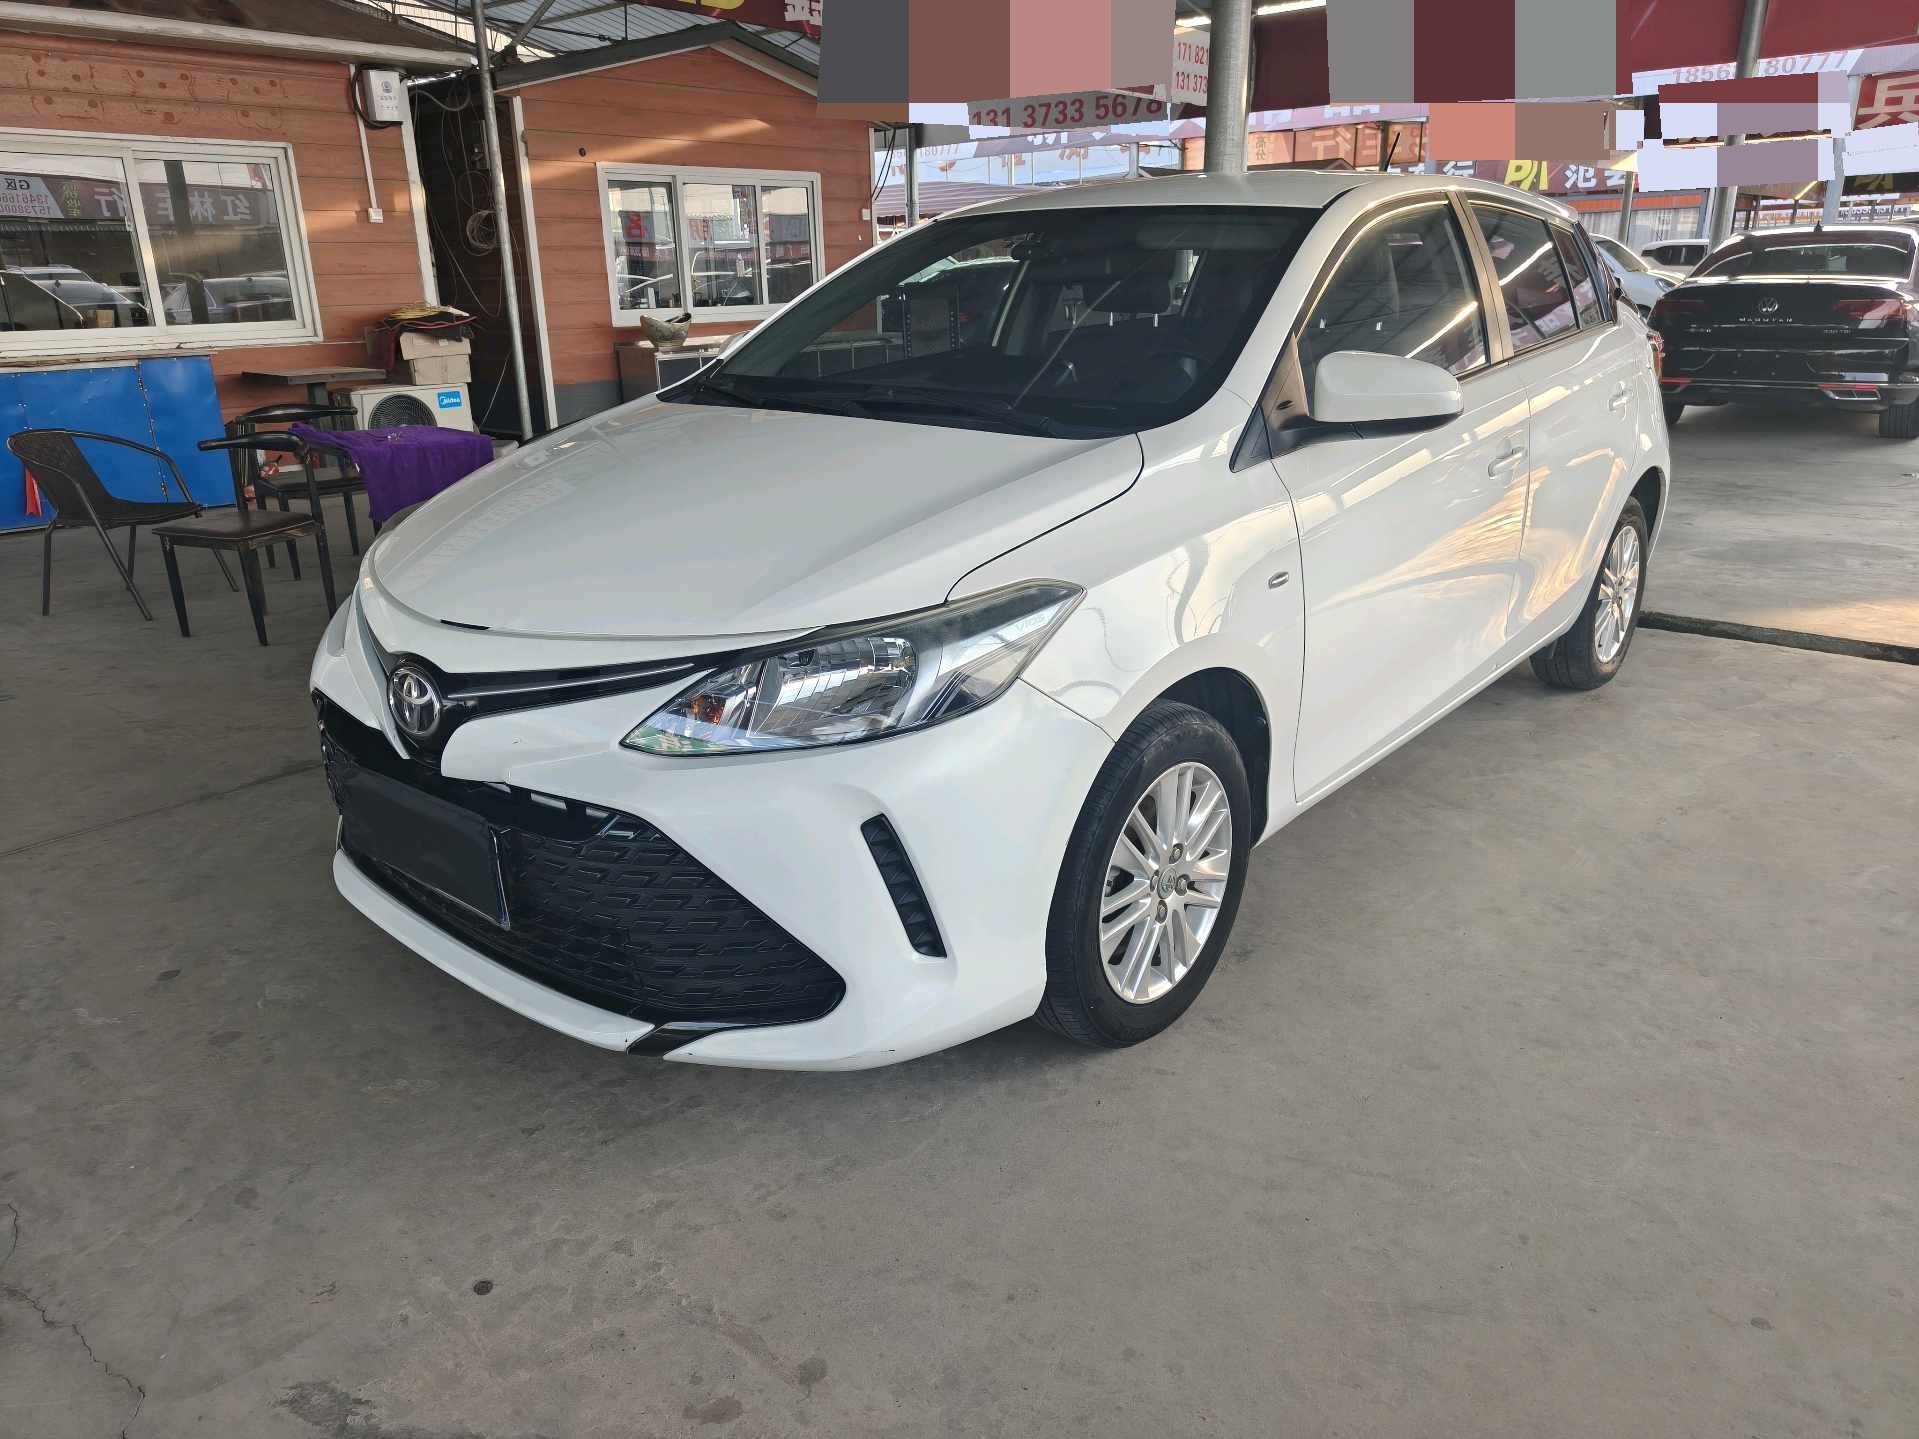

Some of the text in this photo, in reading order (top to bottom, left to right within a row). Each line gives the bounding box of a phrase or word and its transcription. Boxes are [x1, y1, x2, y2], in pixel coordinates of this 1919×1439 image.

[1177, 42, 1192, 62] 171
[1176, 71, 1190, 91] 131
[1023, 98, 1084, 129] 3733
[1095, 93, 1163, 120] 5678
